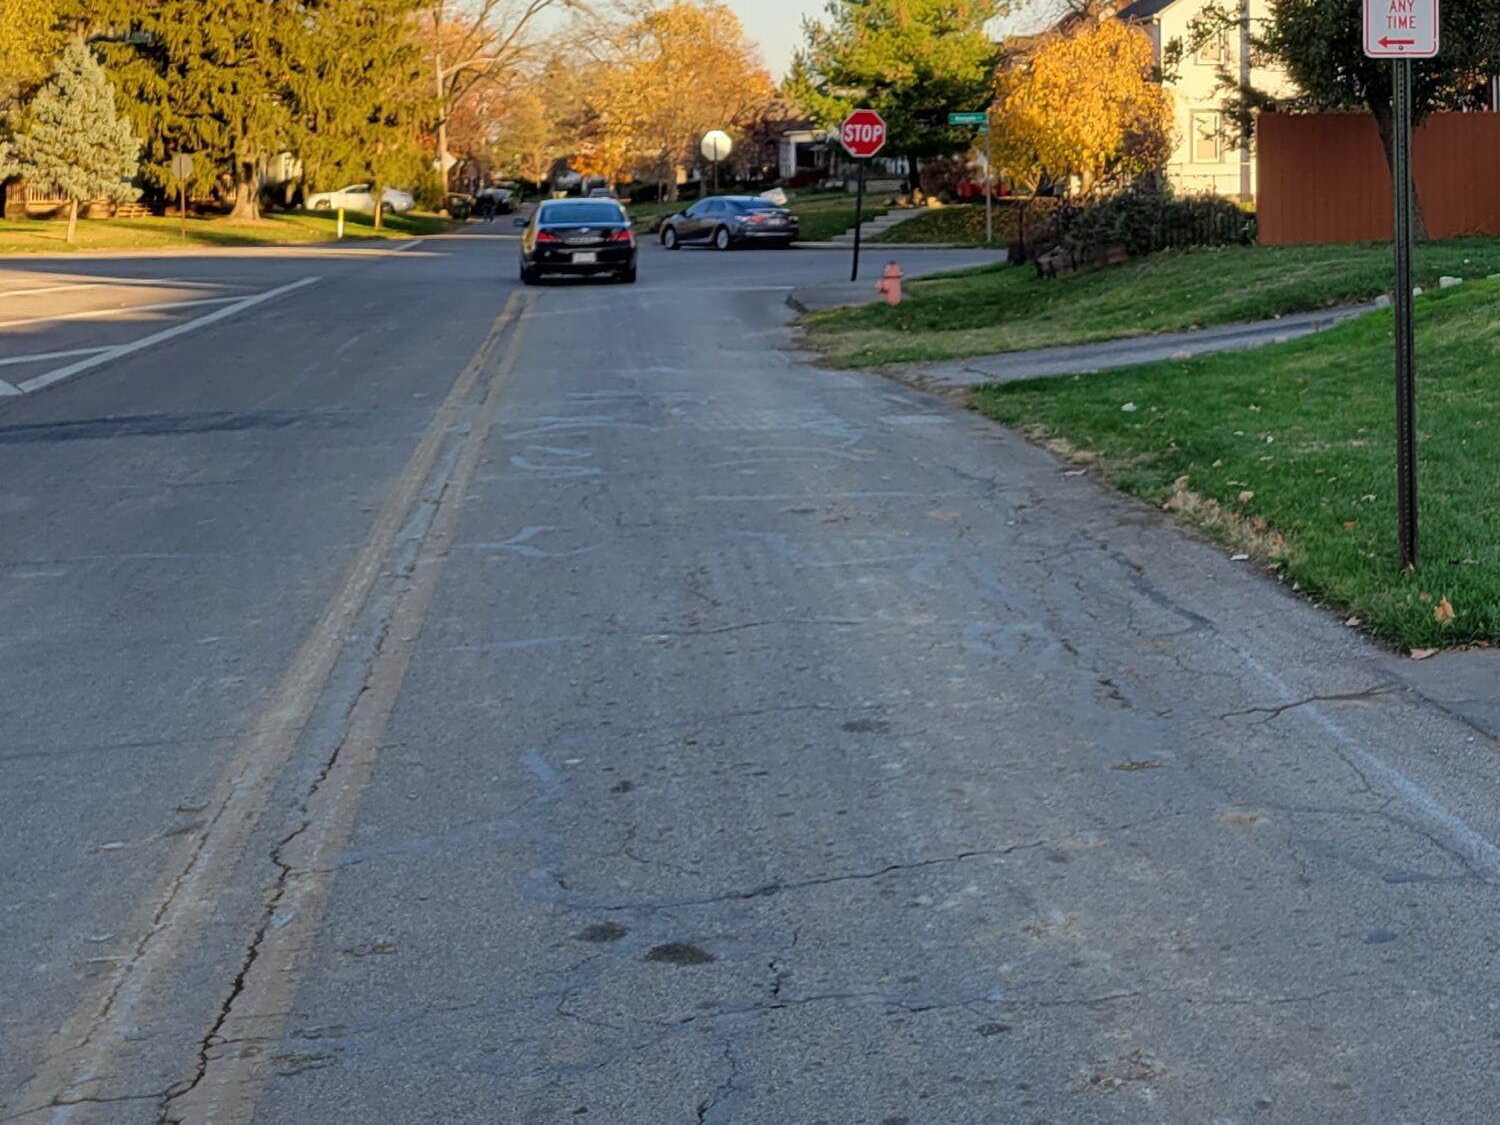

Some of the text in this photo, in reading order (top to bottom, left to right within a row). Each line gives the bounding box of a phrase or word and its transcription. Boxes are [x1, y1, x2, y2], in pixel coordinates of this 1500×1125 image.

[1389, 0, 1415, 13] ANY
[1386, 16, 1417, 29] TIME
[844, 124, 882, 142] STOP
